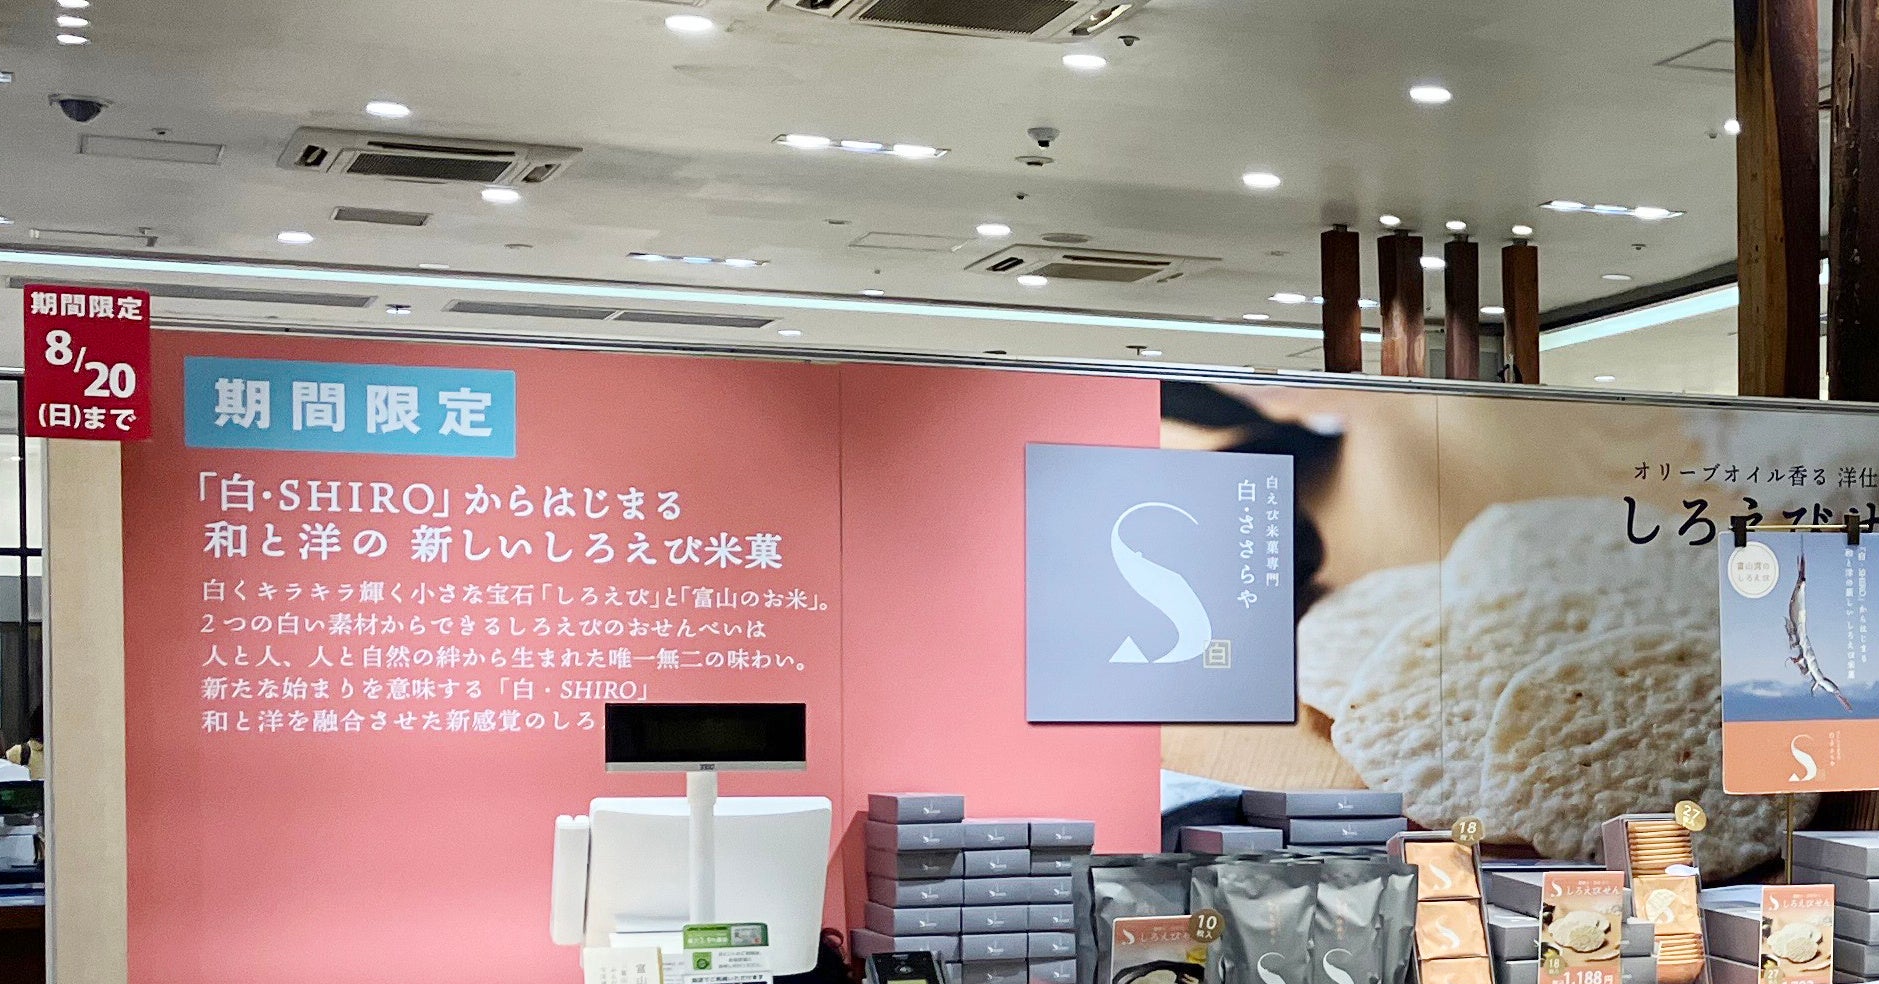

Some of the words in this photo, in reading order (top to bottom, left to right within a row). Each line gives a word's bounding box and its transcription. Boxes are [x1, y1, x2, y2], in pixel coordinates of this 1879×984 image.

[30, 291, 144, 320] 期間限定
[43, 329, 137, 399] 8/20
[213, 377, 494, 438] 期間限定
[201, 708, 605, 735] 和と洋を融合させた新感覚のしろ
[1198, 914, 1217, 930] 10
